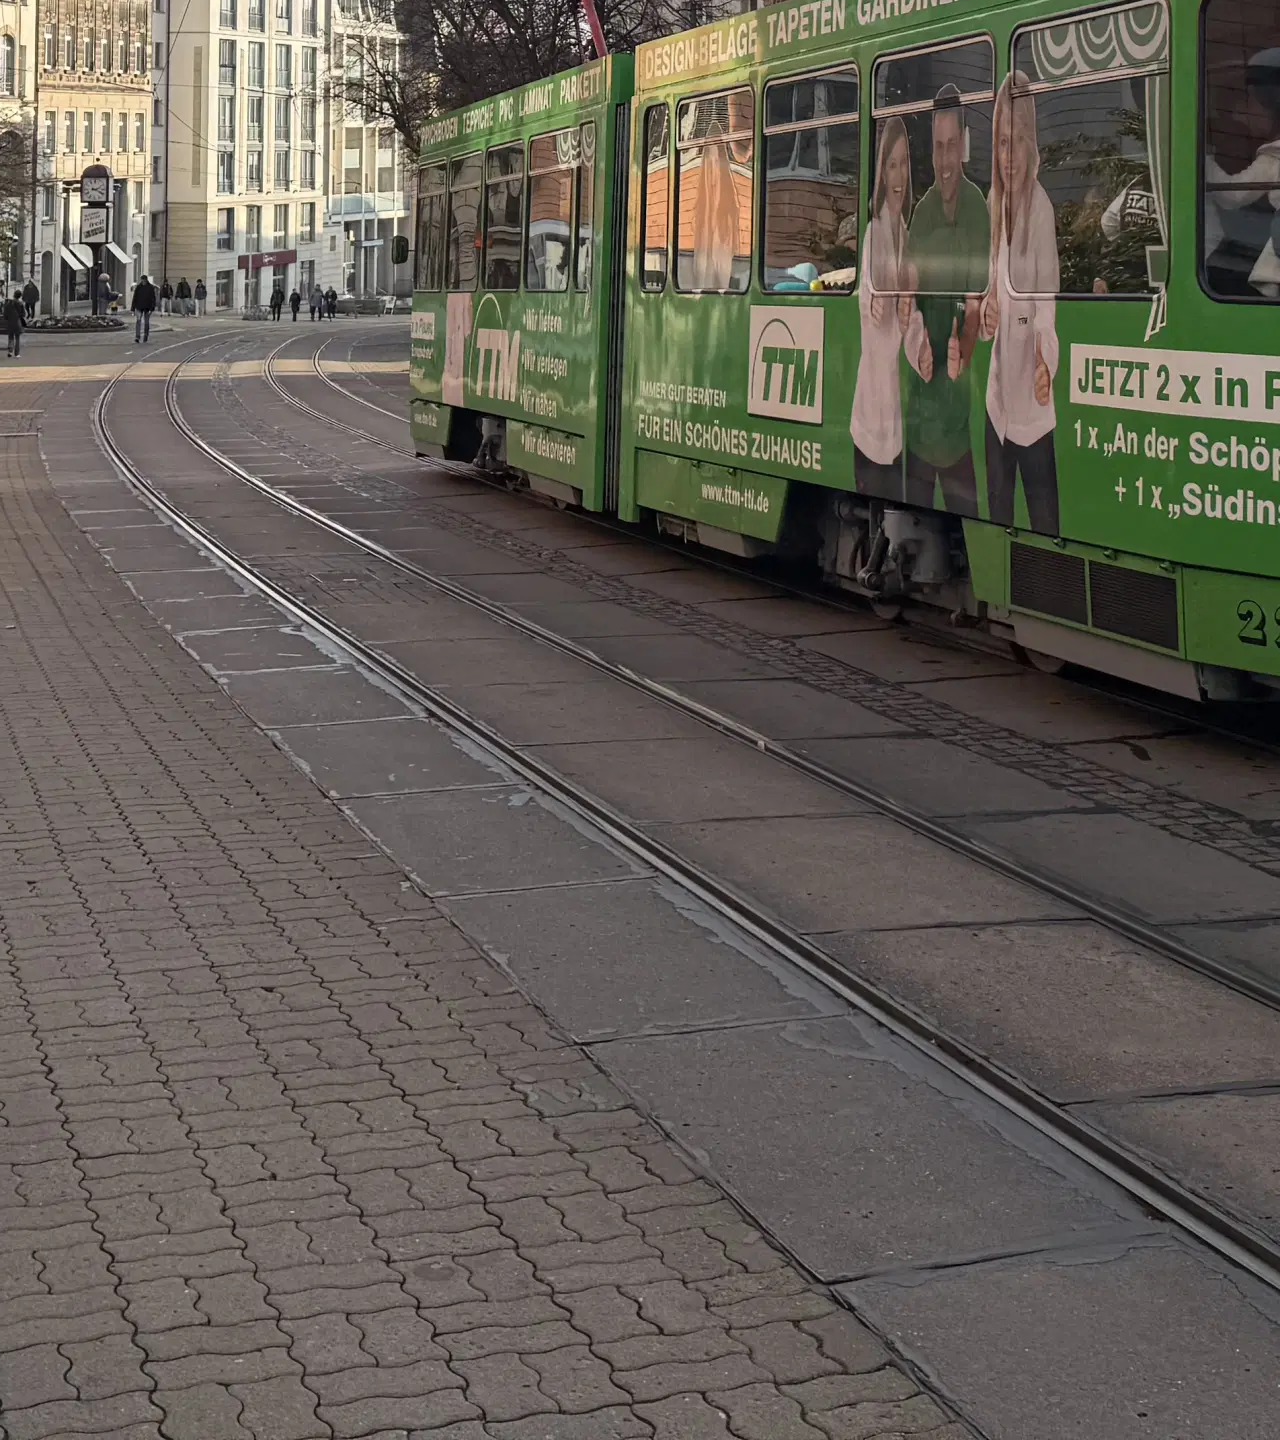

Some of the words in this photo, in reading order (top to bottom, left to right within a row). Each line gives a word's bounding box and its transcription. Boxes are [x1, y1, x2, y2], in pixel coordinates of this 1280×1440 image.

[644, 19, 758, 80] DESIGN-BELÄGE
[462, 103, 494, 135] TEPPICHE
[499, 97, 514, 123] PVC
[519, 82, 554, 116] LAMINAT
[560, 66, 601, 104] PARKETT
[525, 309, 538, 331] Wir
[539, 310, 562, 333] liefern
[476, 328, 520, 403] TTM
[524, 348, 536, 371] Wir
[536, 351, 567, 380] verlegen
[762, 346, 819, 408] TTM
[1077, 357, 1150, 399] JETZT
[1156, 364, 1170, 402] 2
[1179, 373, 1202, 405] x
[1214, 367, 1249, 409] in
[522, 388, 534, 413] Wir
[535, 392, 557, 418] nähen
[640, 380, 666, 401] IMMER
[668, 384, 686, 402] GUT
[687, 386, 726, 408] BERATEN
[524, 429, 536, 453] Wir
[537, 432, 576, 465] dekorieren
[663, 418, 682, 444] EIN
[685, 420, 748, 456] SCHÖNES
[751, 432, 822, 471] ZUHAUSE
[1074, 419, 1082, 448] 1
[1087, 426, 1099, 449] x
[1144, 427, 1178, 461] der
[1114, 476, 1127, 503] +
[1135, 476, 1144, 507] 1
[1150, 484, 1163, 510] x
